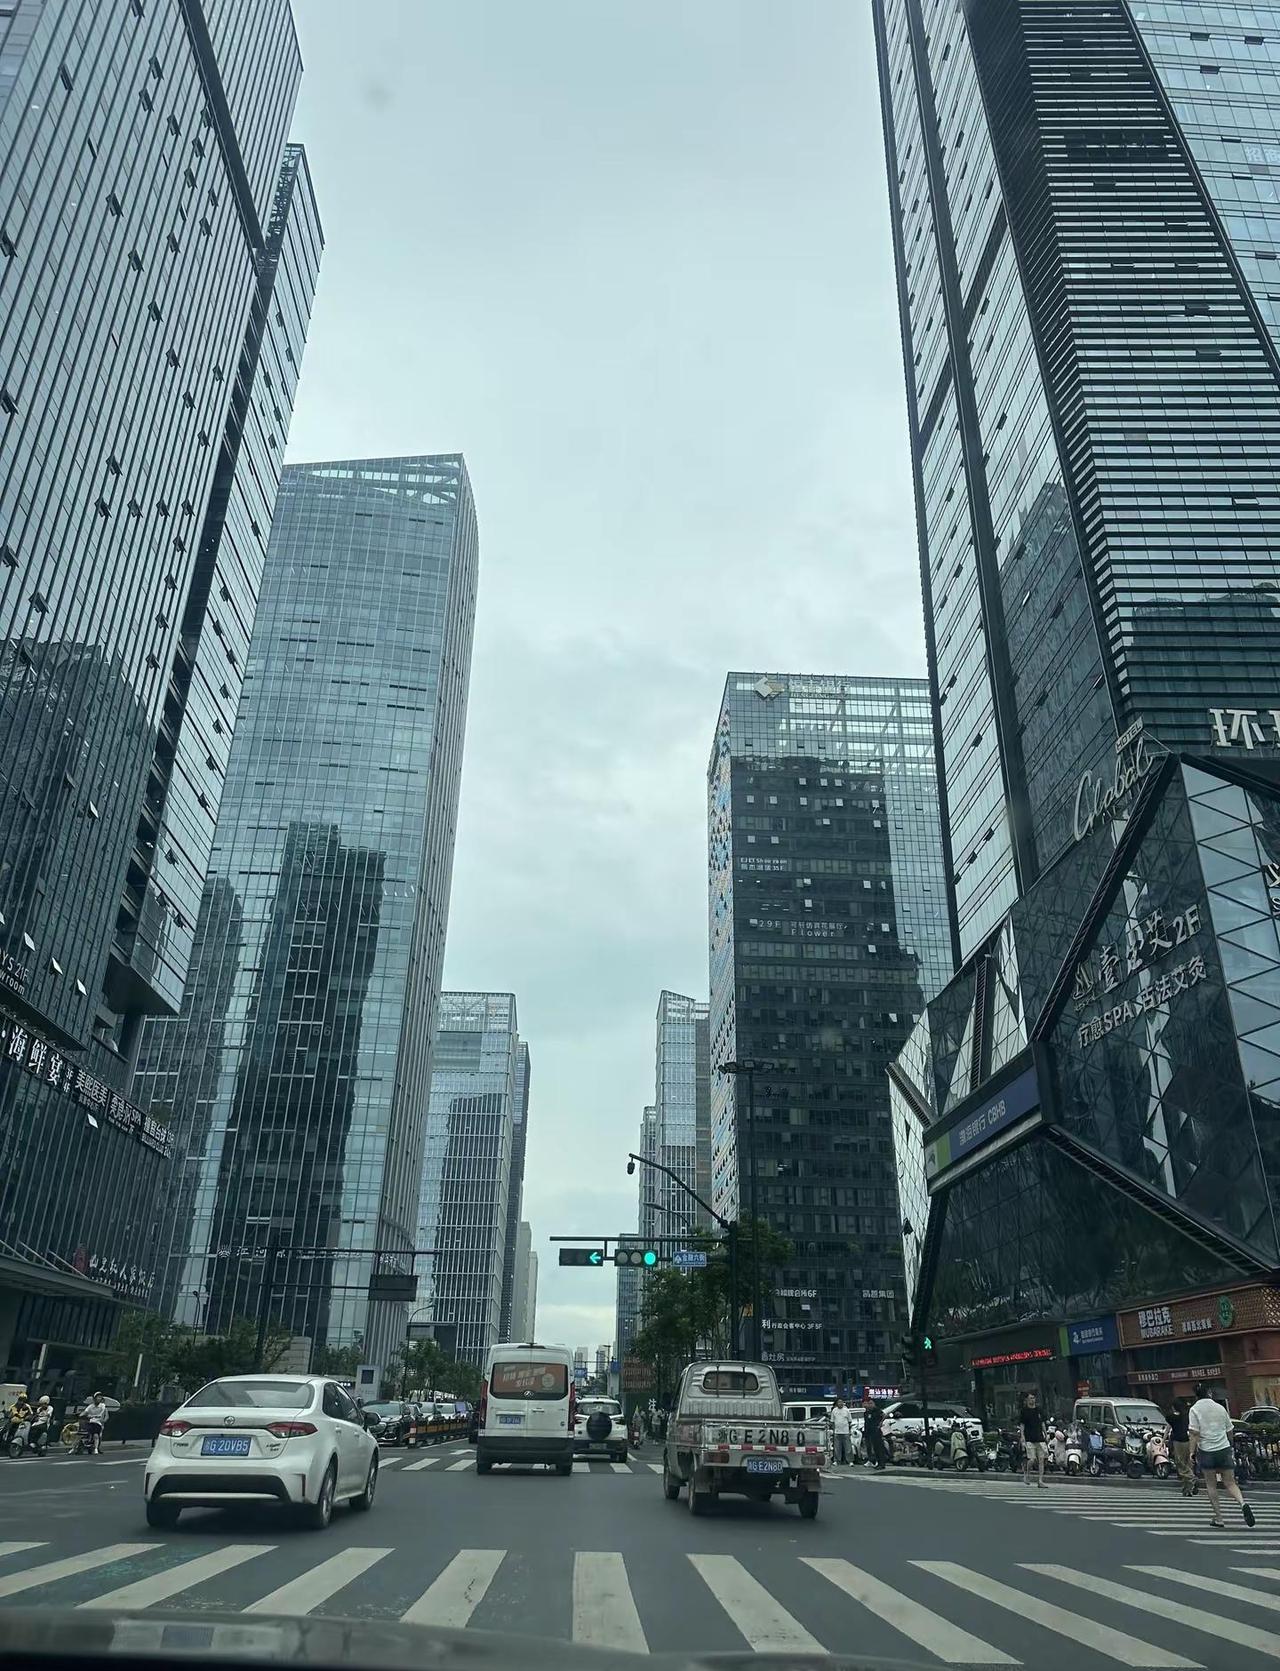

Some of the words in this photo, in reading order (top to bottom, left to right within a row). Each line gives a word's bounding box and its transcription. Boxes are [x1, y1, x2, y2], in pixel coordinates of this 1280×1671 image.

[1116, 719, 1143, 751] HOTEL
[1209, 708, 1280, 750] 环
[1074, 736, 1154, 842] Global
[791, 929, 836, 937] Flower
[1172, 903, 1201, 945] 2F
